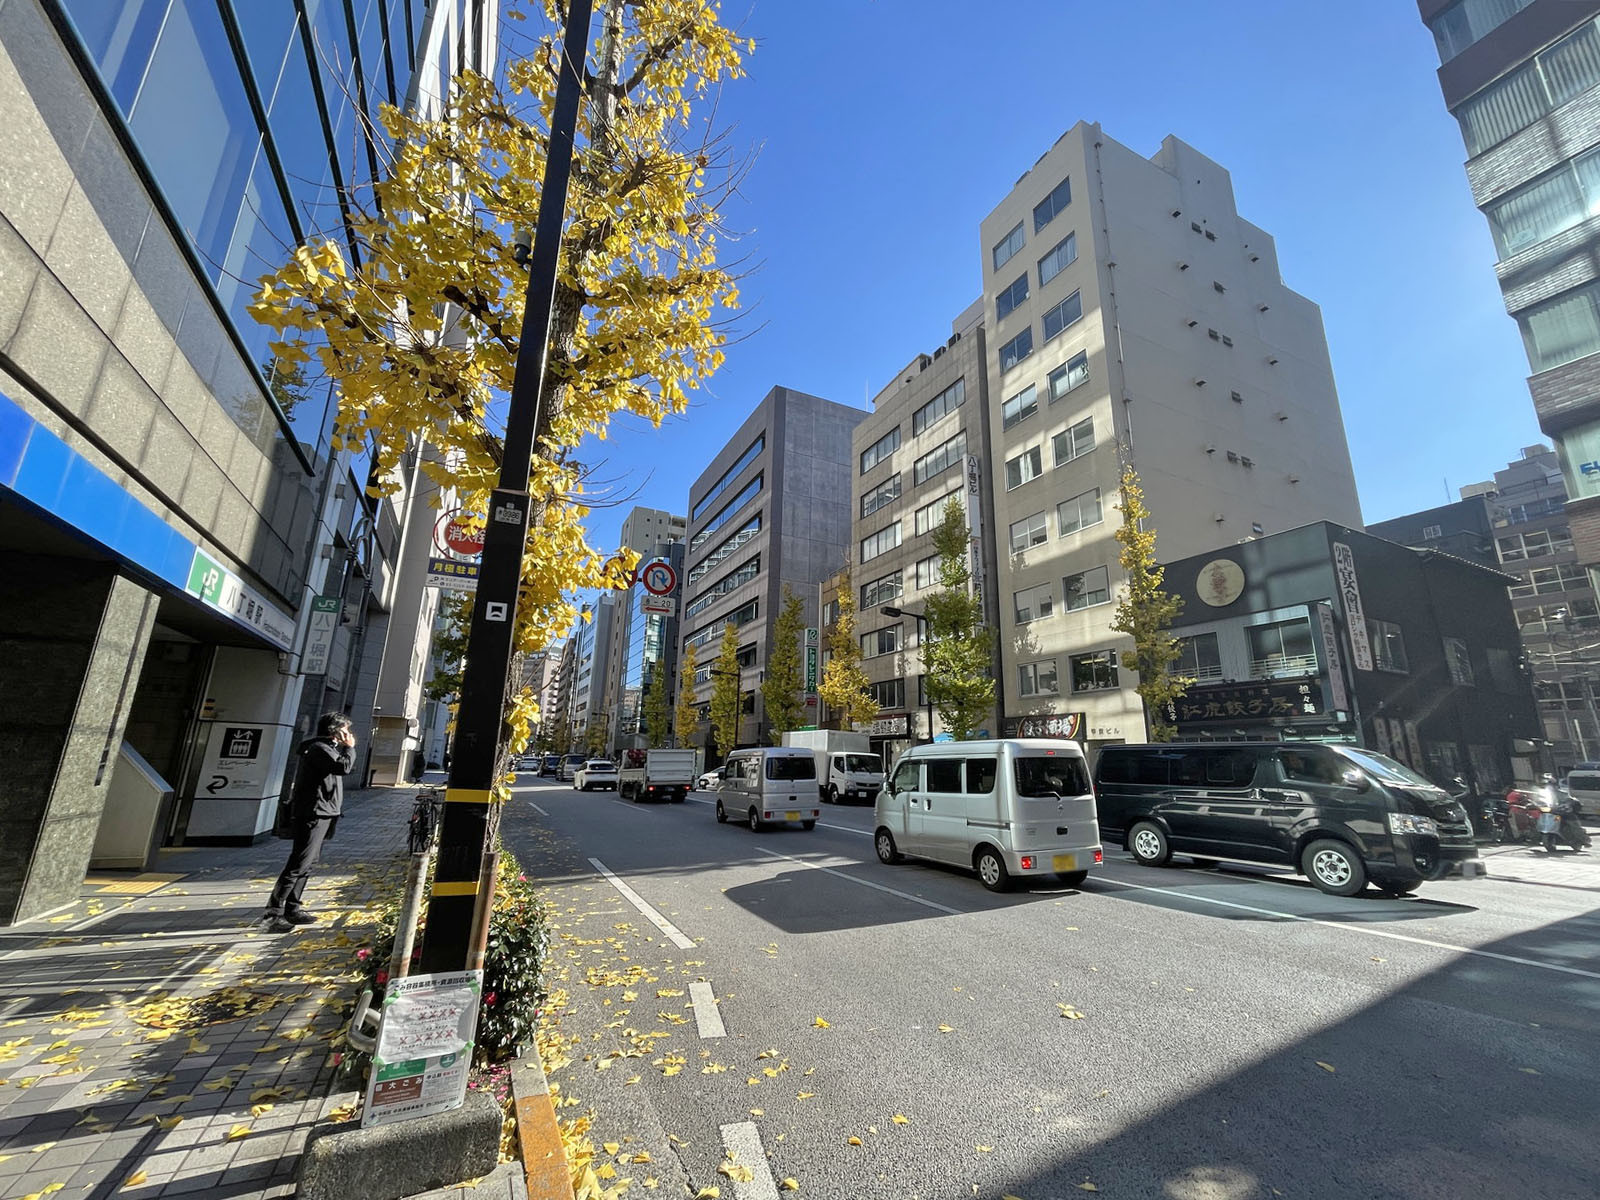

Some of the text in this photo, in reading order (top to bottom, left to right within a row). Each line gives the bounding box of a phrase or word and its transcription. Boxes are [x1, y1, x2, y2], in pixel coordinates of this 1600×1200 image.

[202, 567, 219, 591] JR
[433, 562, 478, 576] 月極駐車
[226, 585, 264, 625] 八丁堀駅
[318, 600, 337, 609] JR
[306, 613, 331, 672] 八丁堀駅
